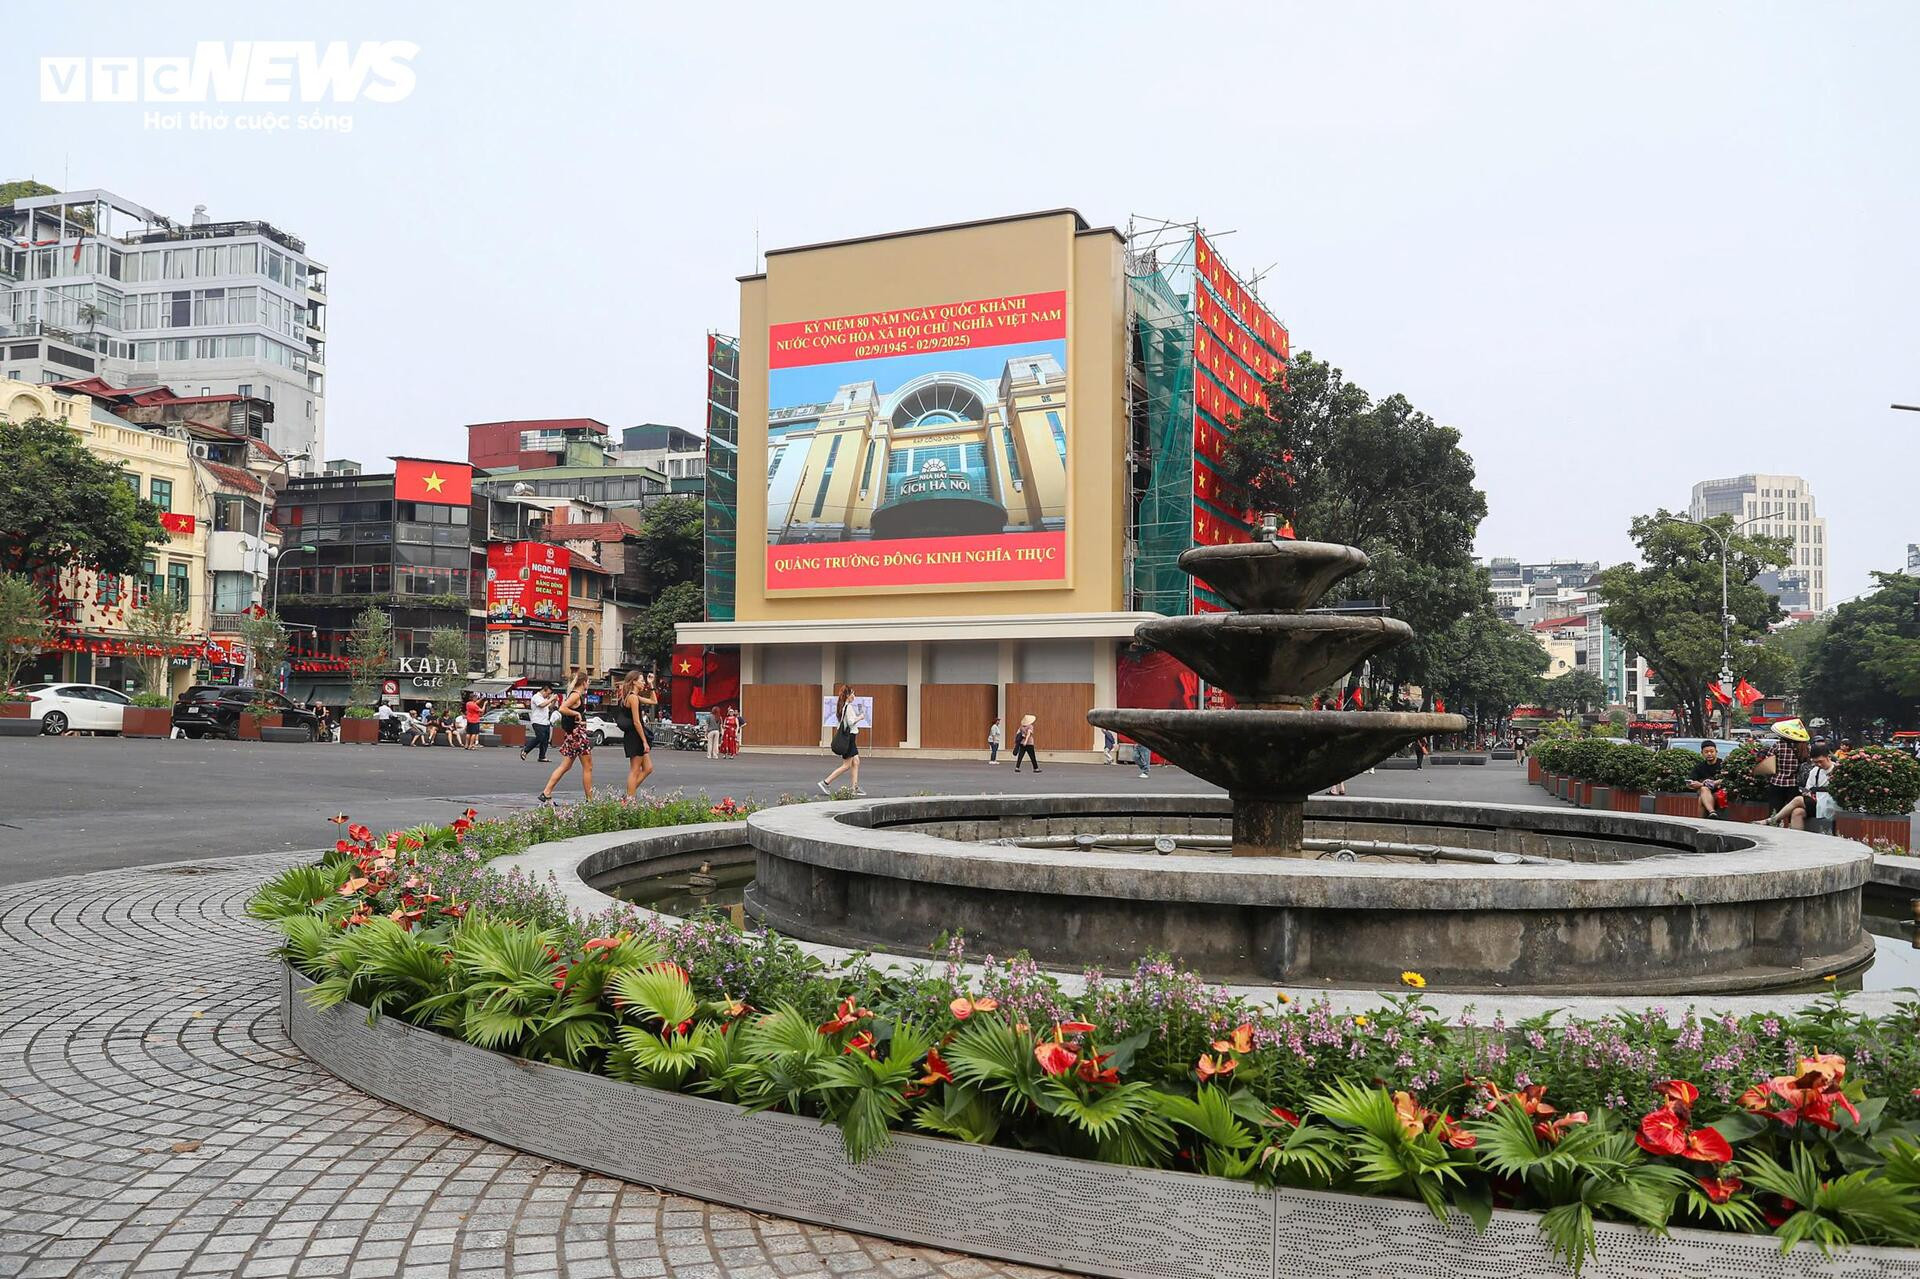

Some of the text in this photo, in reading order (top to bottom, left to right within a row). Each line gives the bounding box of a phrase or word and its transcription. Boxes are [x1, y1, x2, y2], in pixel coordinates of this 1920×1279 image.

[823, 319, 855, 333] NIỆM
[857, 317, 869, 328] 80
[872, 313, 899, 326] NĂM
[903, 306, 937, 323] NGÀY
[940, 302, 977, 319] QUỐC
[980, 297, 1026, 314] KHÁNH
[776, 309, 1061, 351] NƯỚC CỘNG HÒA XÃ HỘI CHỦ NGHĨA VIỆT NAM
[855, 341, 907, 358] (02/9/1945
[916, 335, 971, 350] 02/9/2025)
[553, 567, 567, 576] HOA
[775, 547, 1056, 573] QUẢNG TRƯỜNG ĐÔNG KINH NGHĨA THỤC
[413, 676, 444, 688] Café
